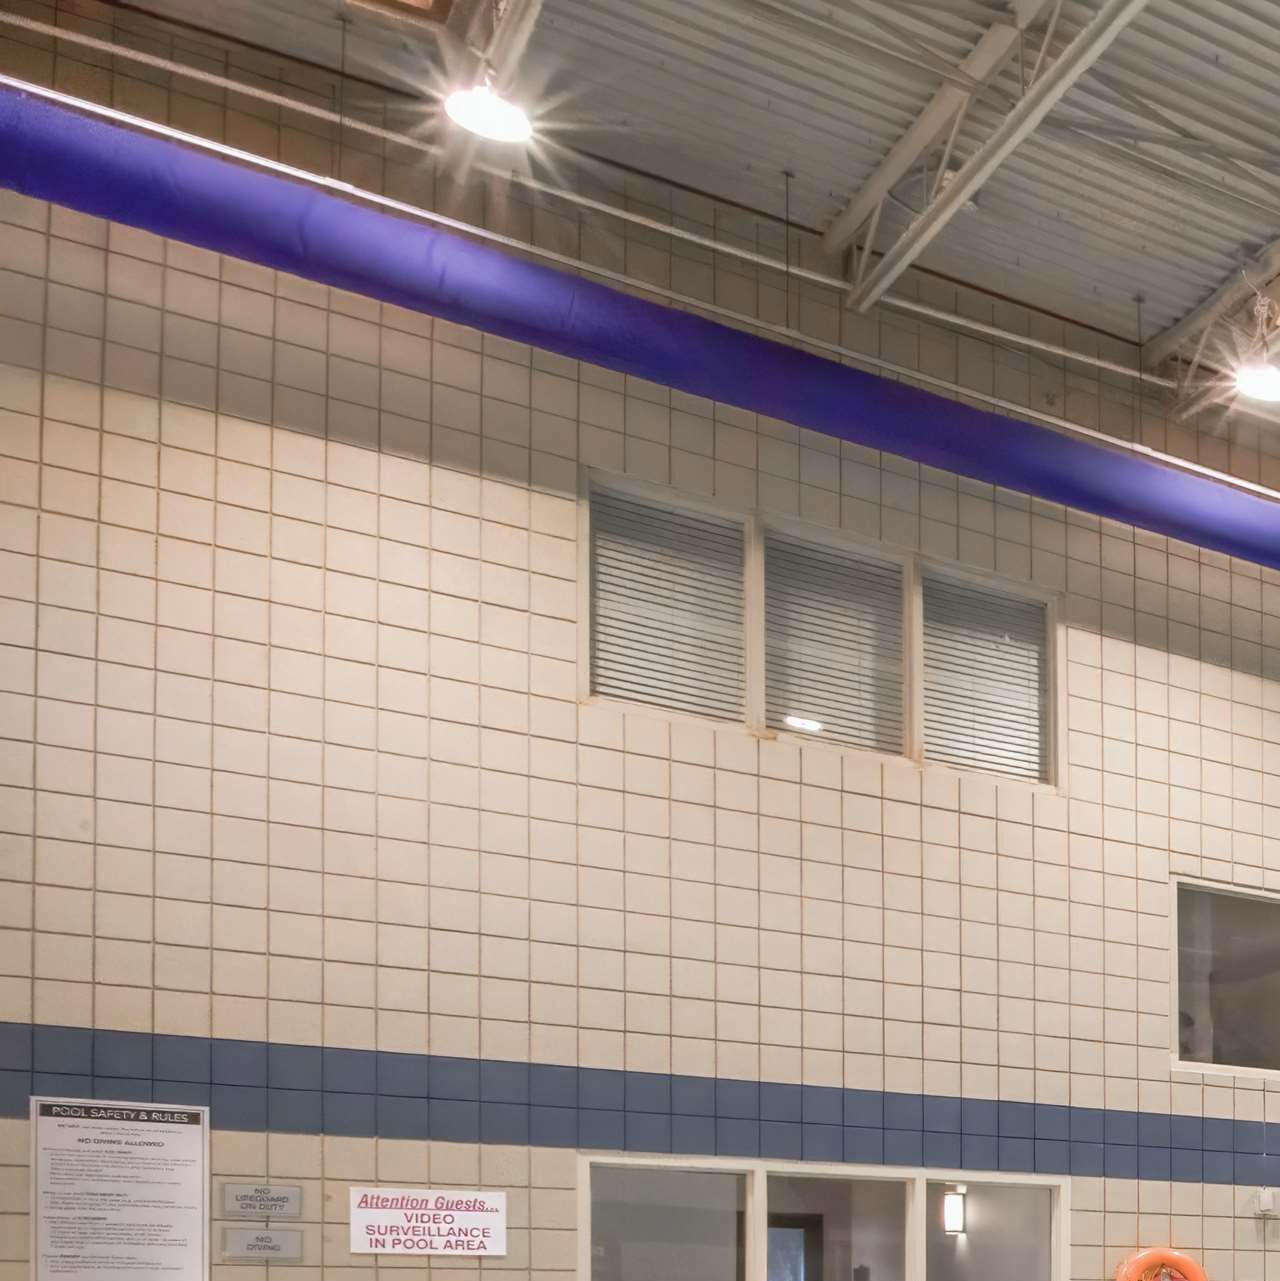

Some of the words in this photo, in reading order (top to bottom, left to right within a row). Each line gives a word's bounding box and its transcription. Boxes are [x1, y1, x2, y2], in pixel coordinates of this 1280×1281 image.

[52, 1106, 87, 1117] POOL
[90, 1109, 137, 1120] SAFETY
[139, 1112, 148, 1120] &
[152, 1112, 189, 1122] RULES
[357, 1193, 429, 1209] Attention
[404, 1213, 455, 1224] VIDEO
[365, 1225, 491, 1238] SURVEILLANCE
[369, 1238, 386, 1248] IN
[392, 1238, 438, 1250] POOL
[443, 1240, 487, 1250] AREA
